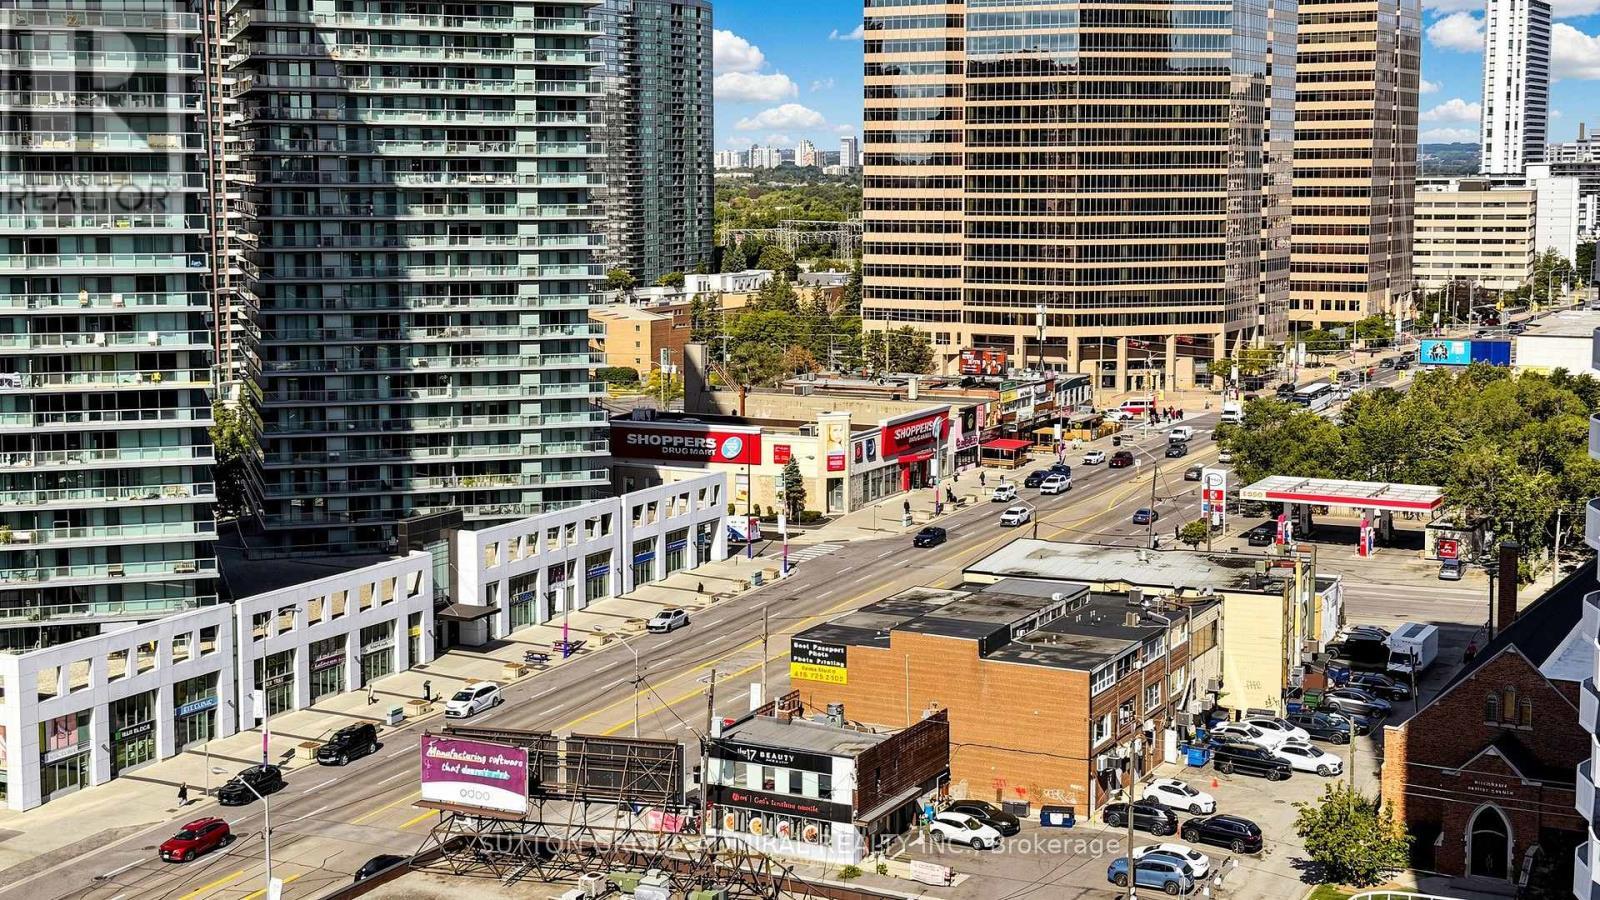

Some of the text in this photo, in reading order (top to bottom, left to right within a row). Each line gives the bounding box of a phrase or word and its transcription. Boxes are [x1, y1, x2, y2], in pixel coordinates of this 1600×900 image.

[894, 420, 934, 440] SHOPPERS
[626, 433, 717, 449] SHOPPERS
[662, 446, 717, 456] DRUG MART
[808, 650, 829, 659] Photo
[812, 644, 844, 654] Passport
[793, 655, 814, 664] Photo
[816, 658, 845, 669] Printing
[426, 746, 523, 767] Manufacturing software
[759, 751, 795, 762] BEAUTY
[441, 762, 461, 774] that
[459, 787, 490, 801] odoo
